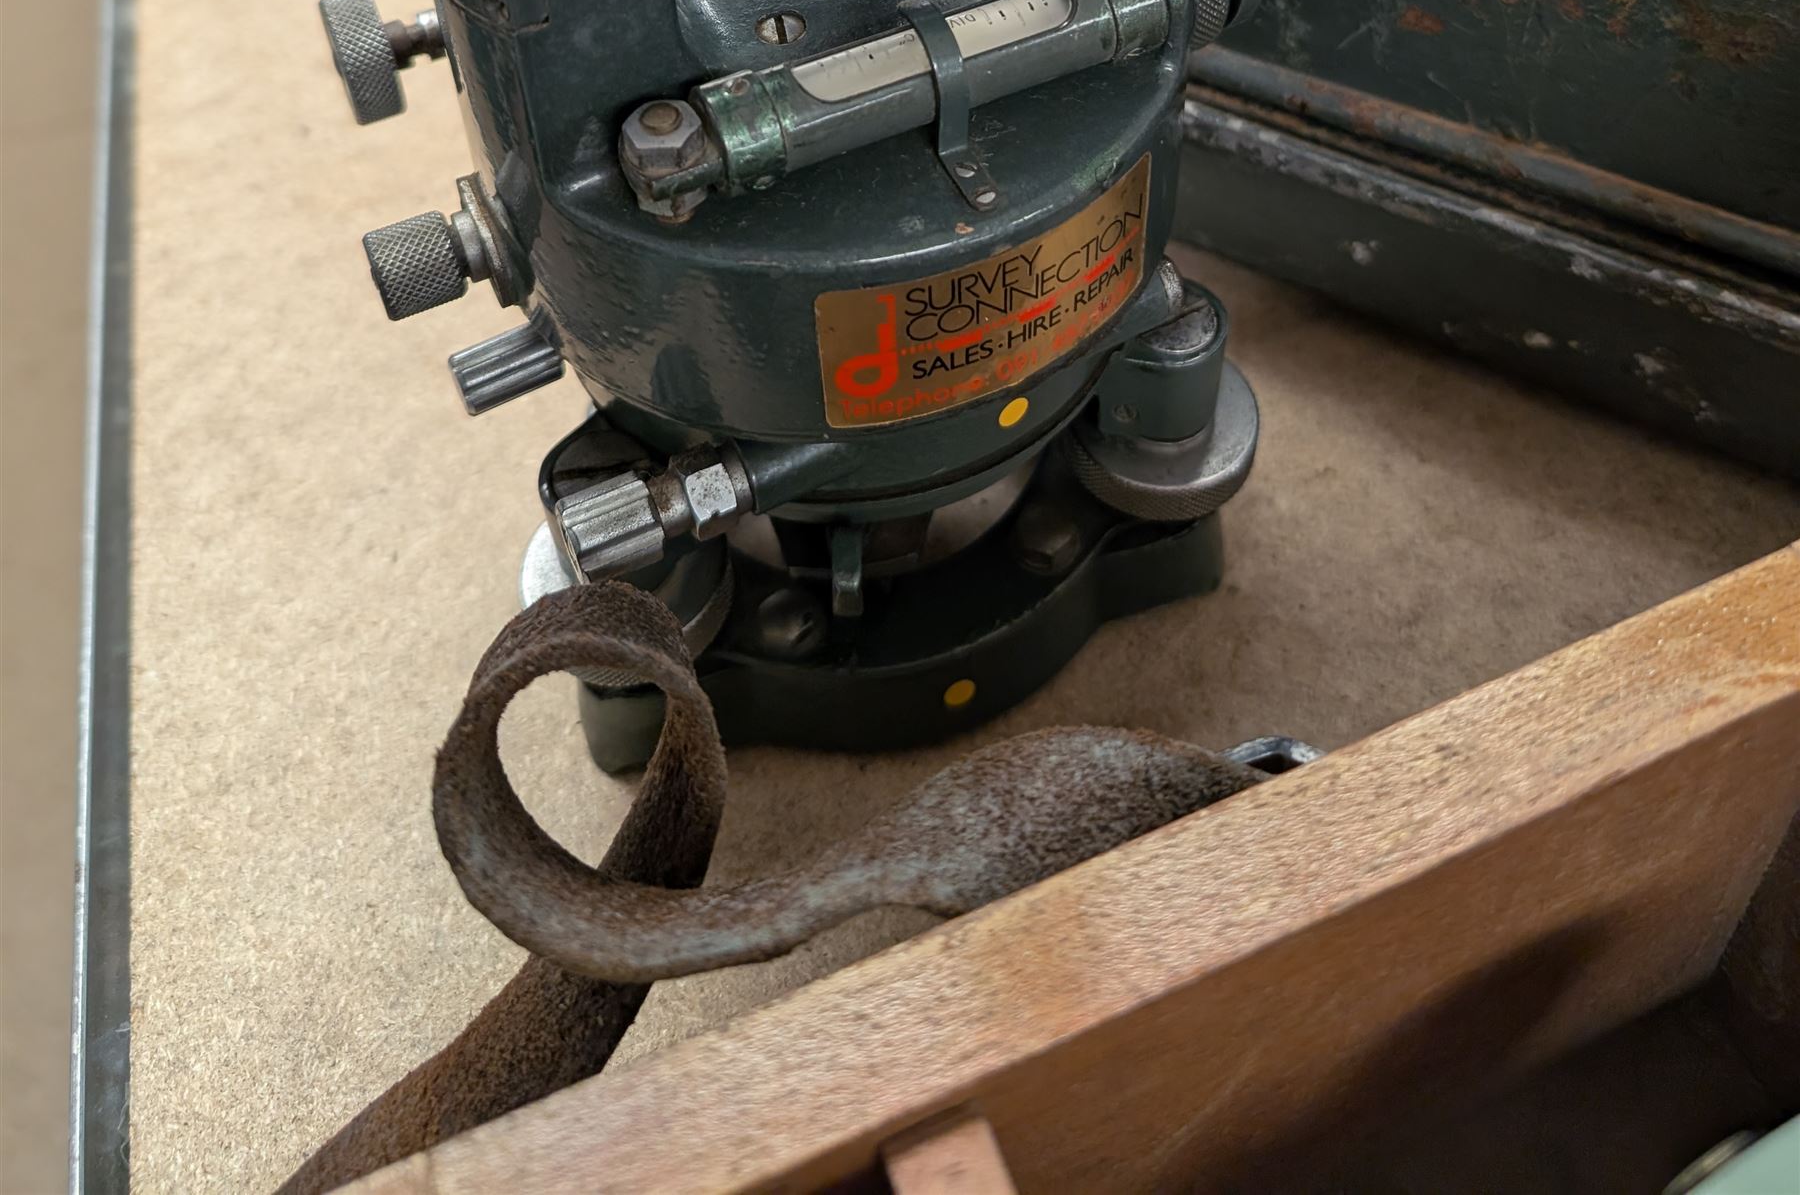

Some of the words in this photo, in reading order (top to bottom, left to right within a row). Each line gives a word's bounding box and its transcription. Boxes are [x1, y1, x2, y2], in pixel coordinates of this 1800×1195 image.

[904, 245, 1042, 316] SURVEY
[905, 193, 1144, 342] CONNECTION
[912, 340, 994, 380] SALES
[1008, 307, 1062, 349] HIRE
[1074, 248, 1134, 312] REPAIR
